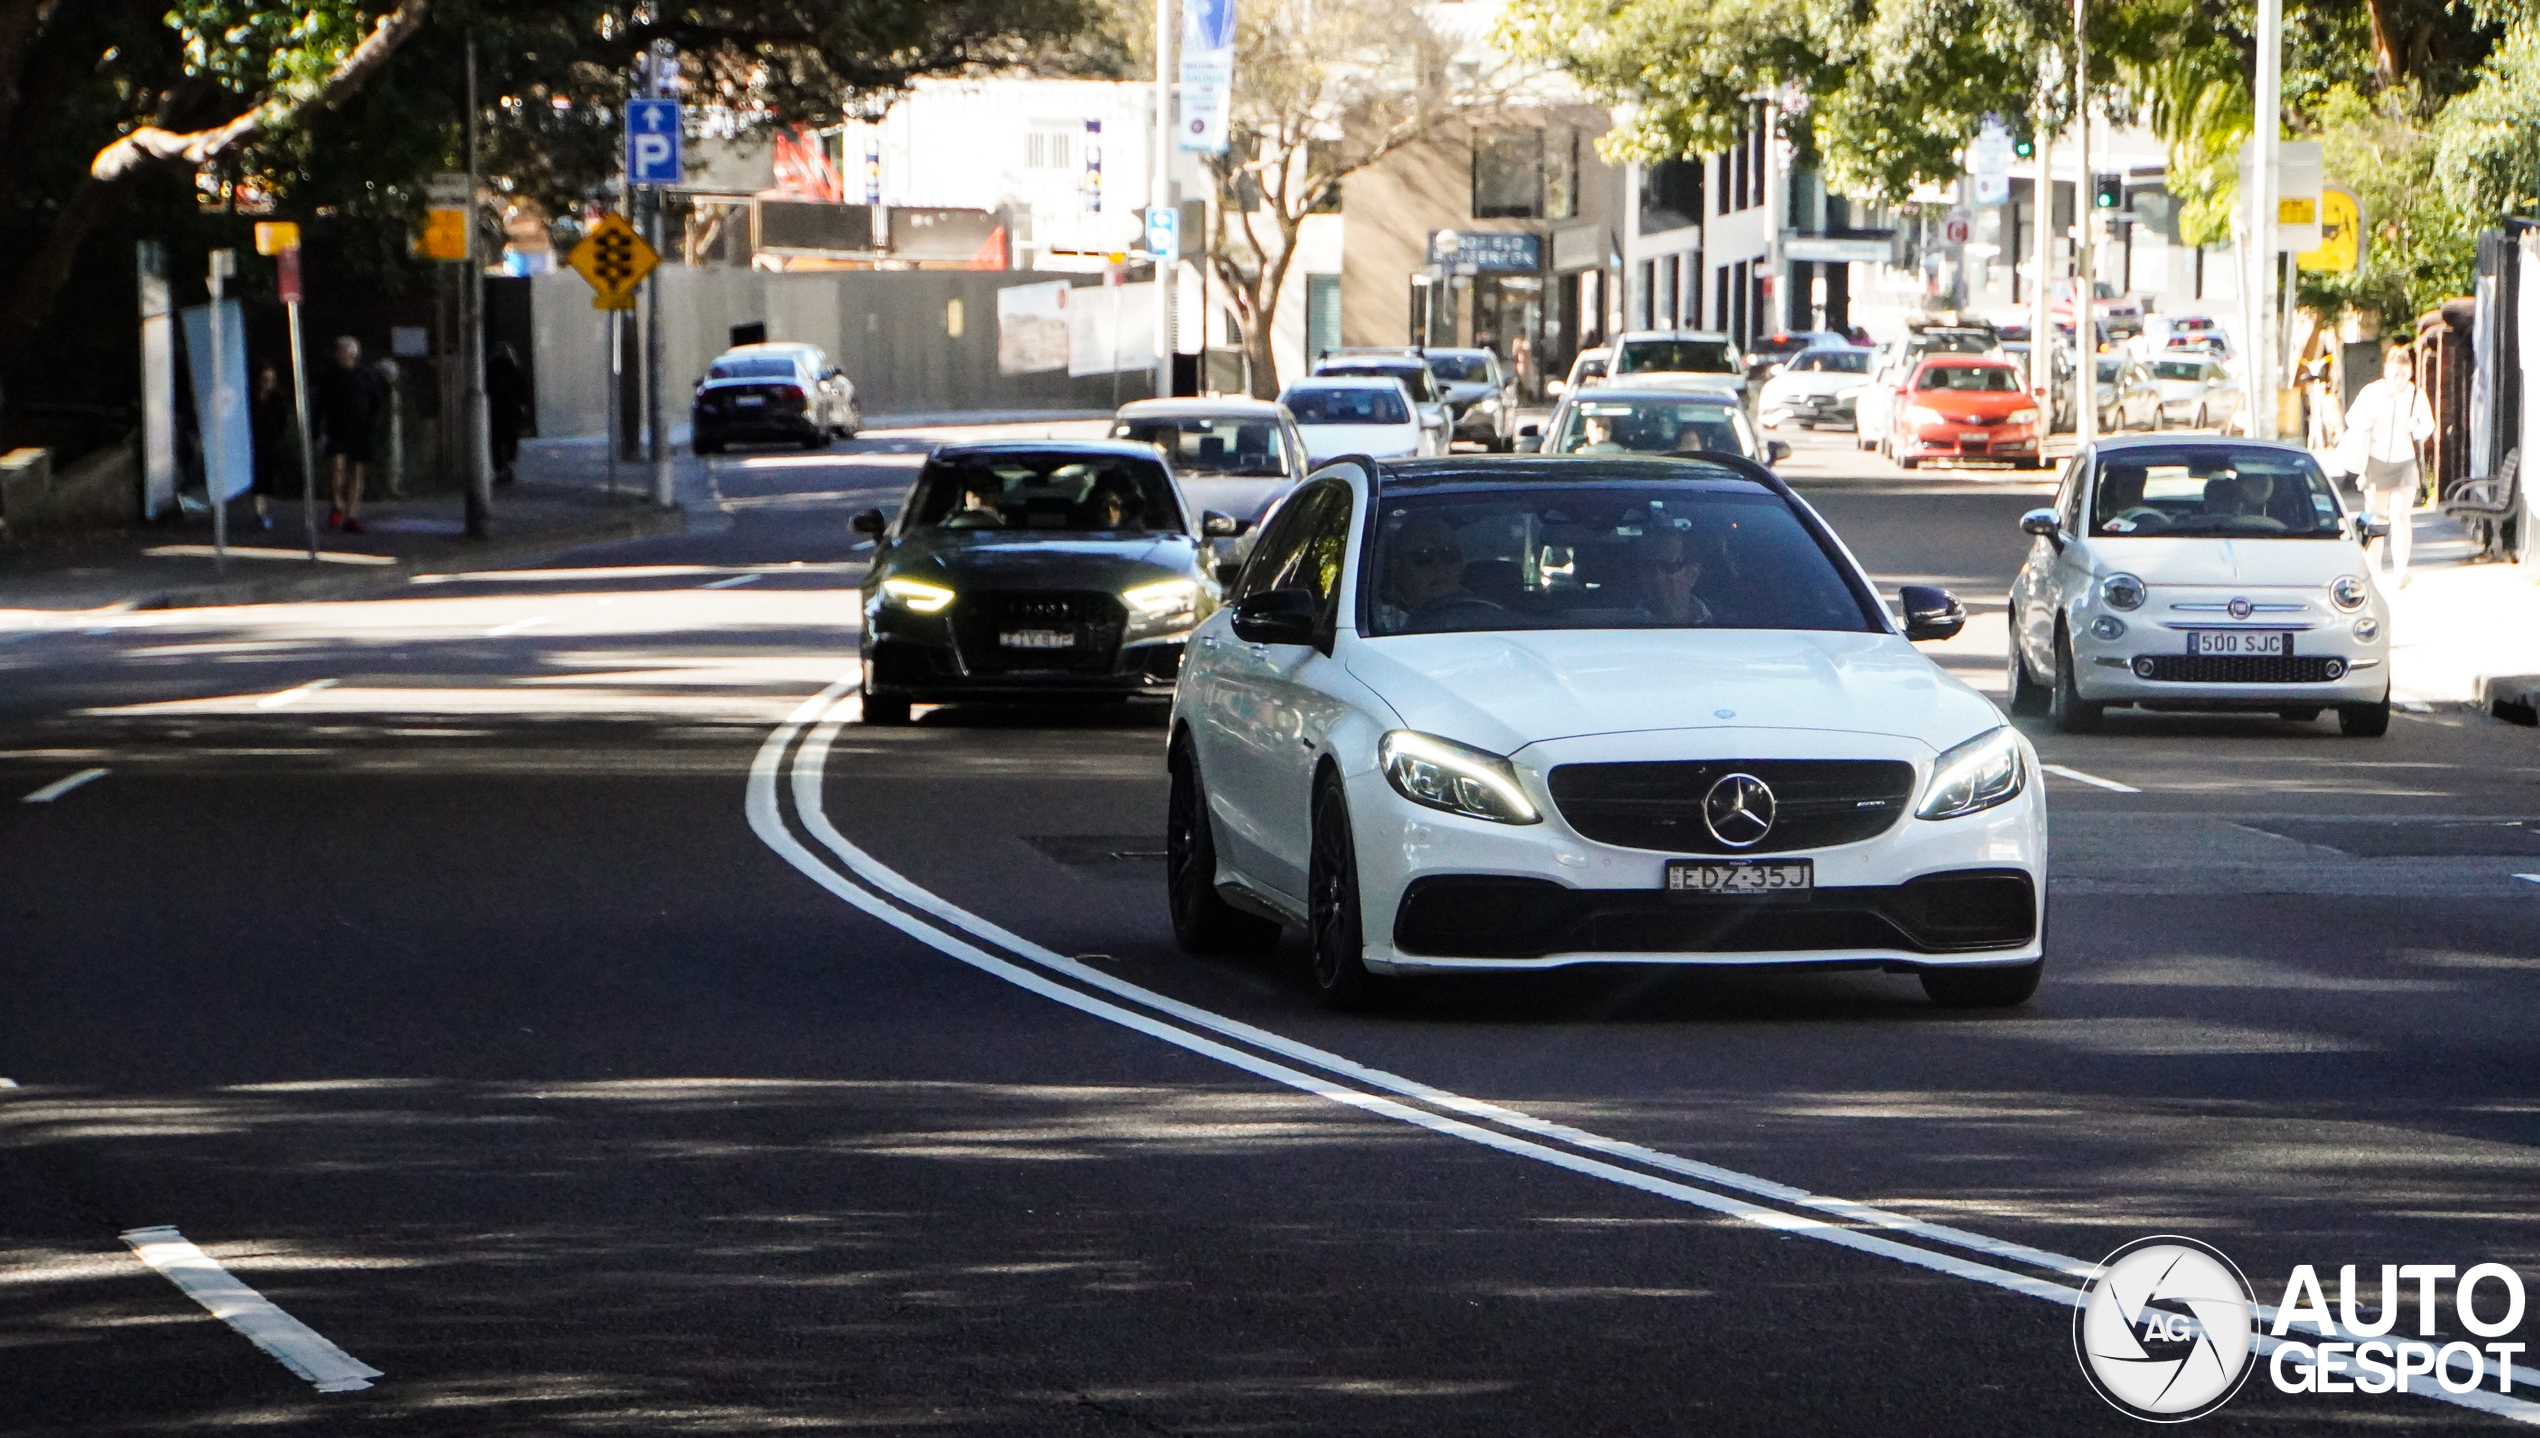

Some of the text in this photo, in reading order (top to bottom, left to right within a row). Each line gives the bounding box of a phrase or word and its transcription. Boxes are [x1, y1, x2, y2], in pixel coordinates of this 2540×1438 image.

[635, 134, 670, 177] P
[2202, 635, 2280, 652] 500 SJC
